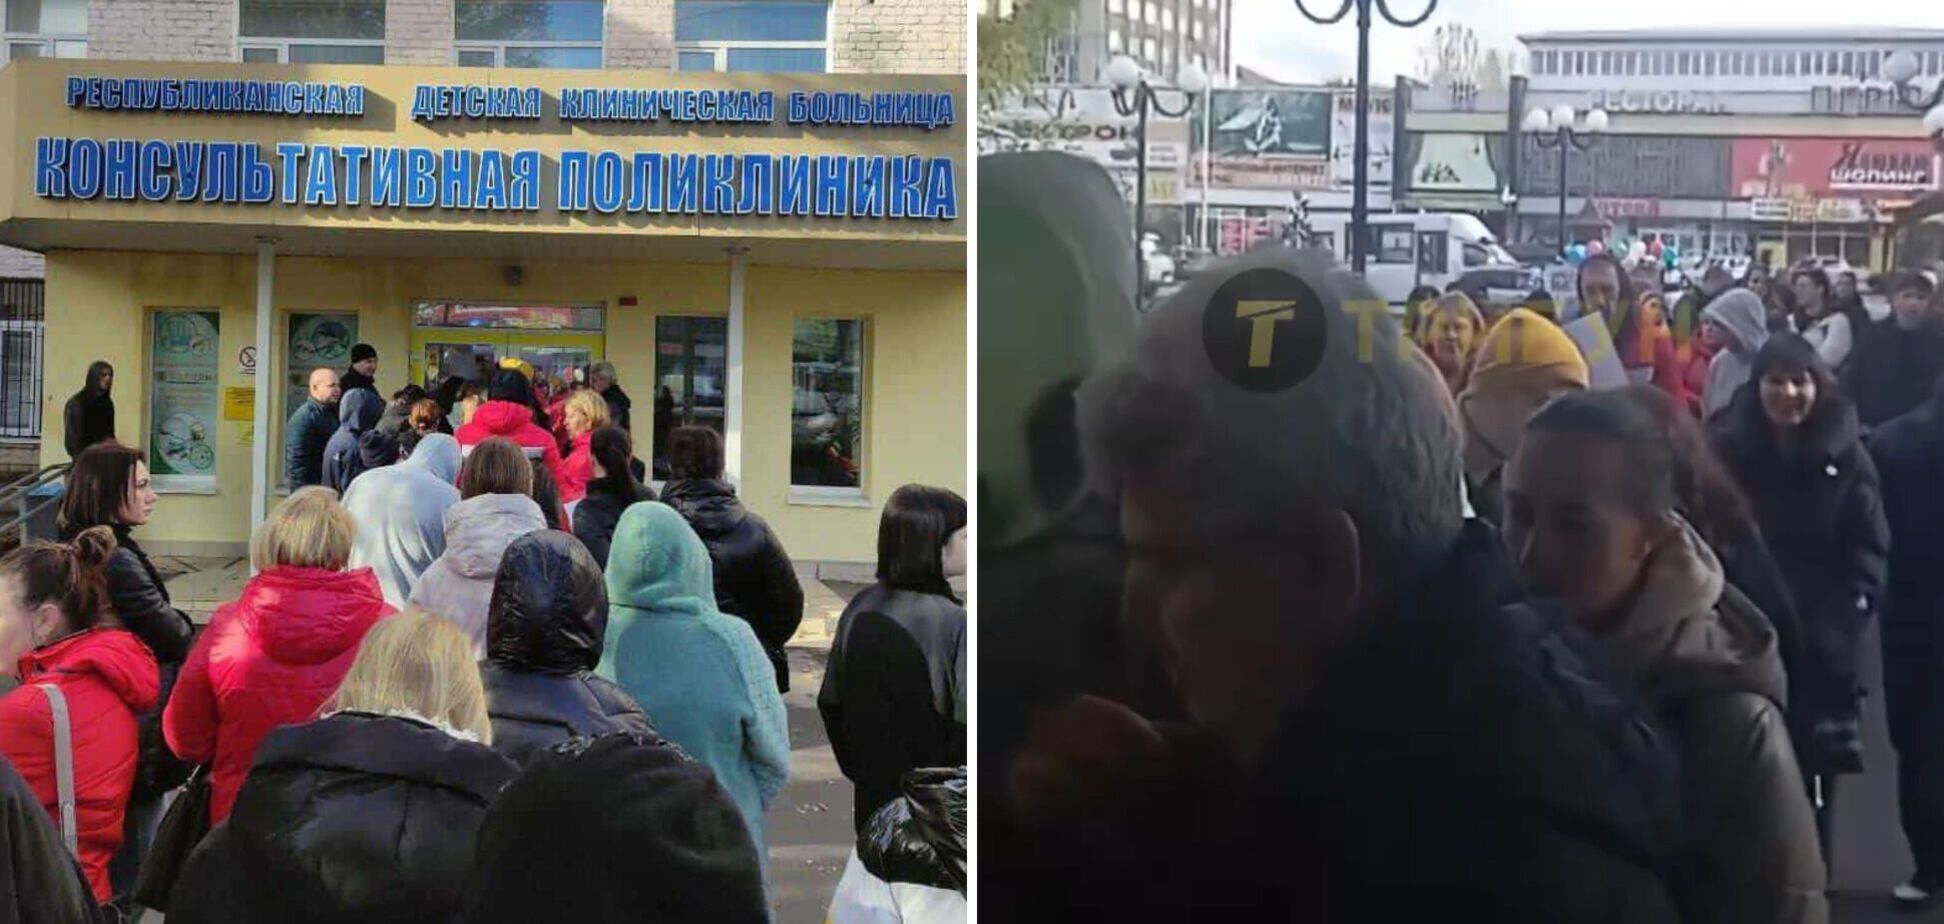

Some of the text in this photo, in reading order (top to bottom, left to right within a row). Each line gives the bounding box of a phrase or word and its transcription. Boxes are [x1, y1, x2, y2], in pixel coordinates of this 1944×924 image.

[66, 76, 365, 115] РЕСПУБЛИКАНСКАЯ
[410, 84, 541, 120] ДЕТСКАЯ
[559, 88, 774, 123] КЛИНИЧЕСКАЯ
[788, 91, 957, 128] БОЛЬНИЦА
[35, 137, 958, 219] КОНСУЛЬТАТИВНАЯ ПОЛИКЛИНИКА
